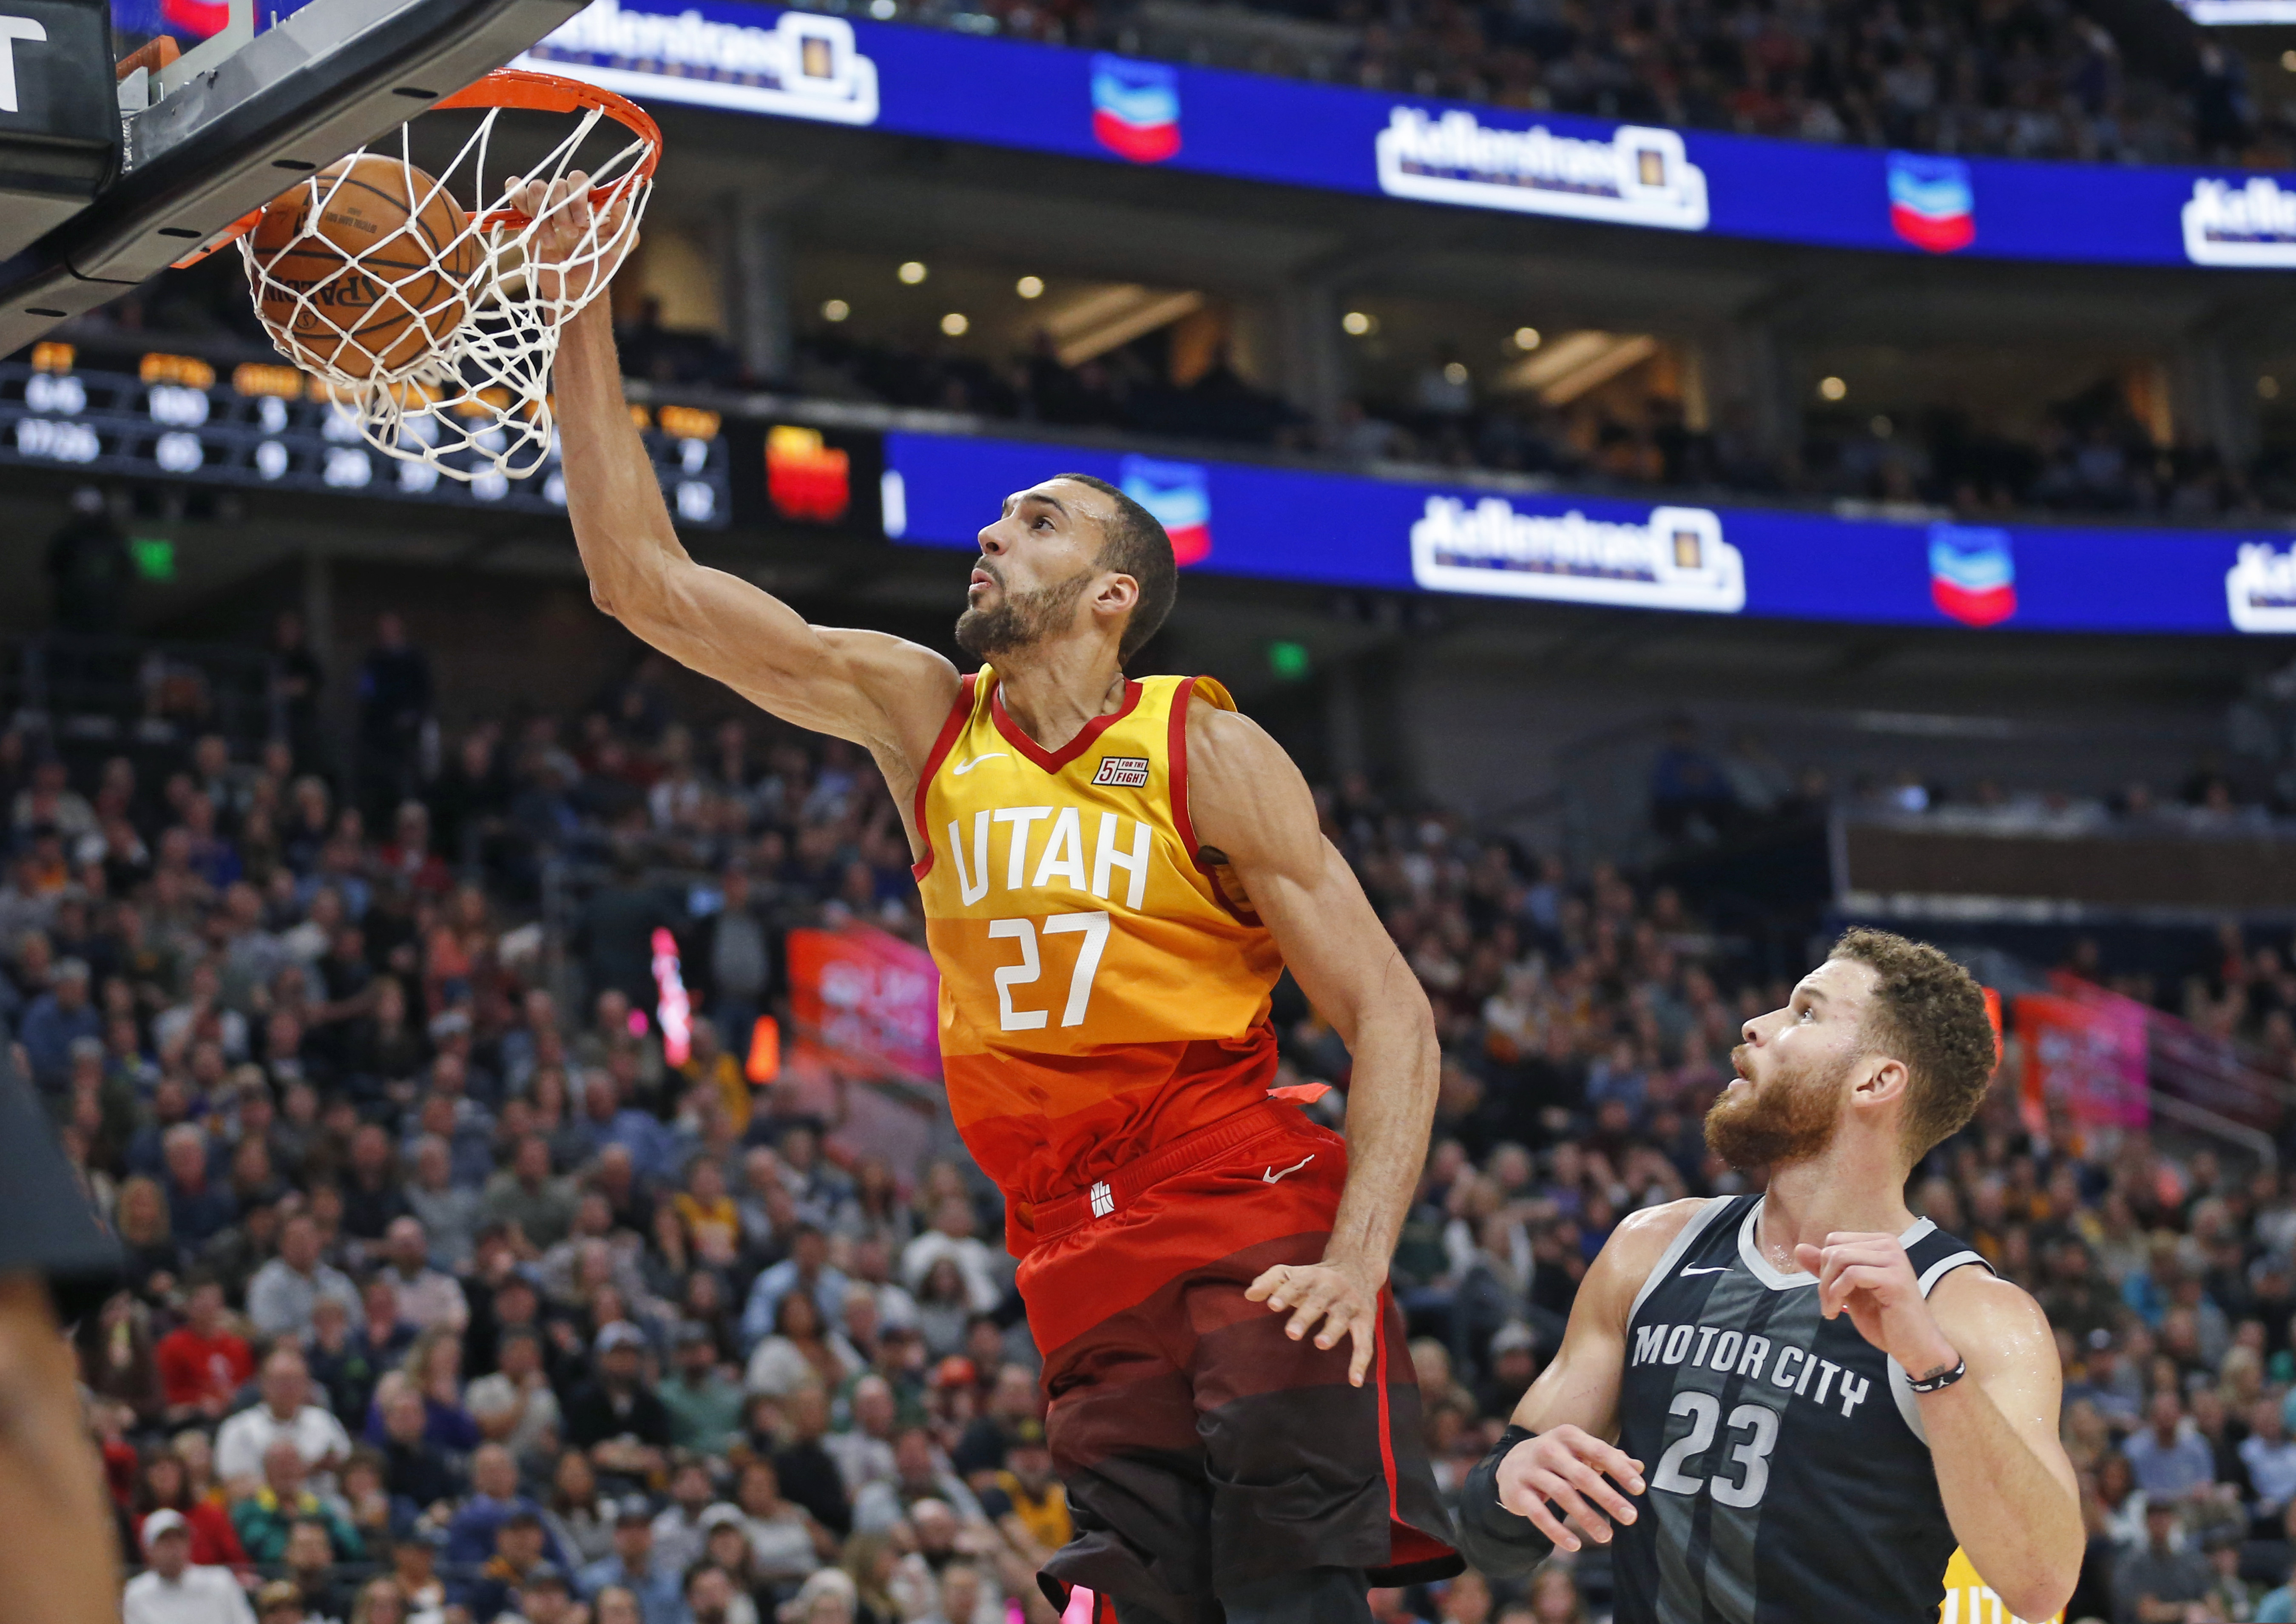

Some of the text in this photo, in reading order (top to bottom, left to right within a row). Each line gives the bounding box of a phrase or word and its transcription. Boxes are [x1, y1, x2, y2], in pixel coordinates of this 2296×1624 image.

[1099, 761, 1116, 781] 5
[1116, 772, 1145, 783] FIGHT
[948, 806, 1151, 910] UTAH
[988, 911, 1110, 1031] 27
[1632, 1324, 1870, 1418] MOTOR CITY
[1651, 1390, 1782, 1508] 23
